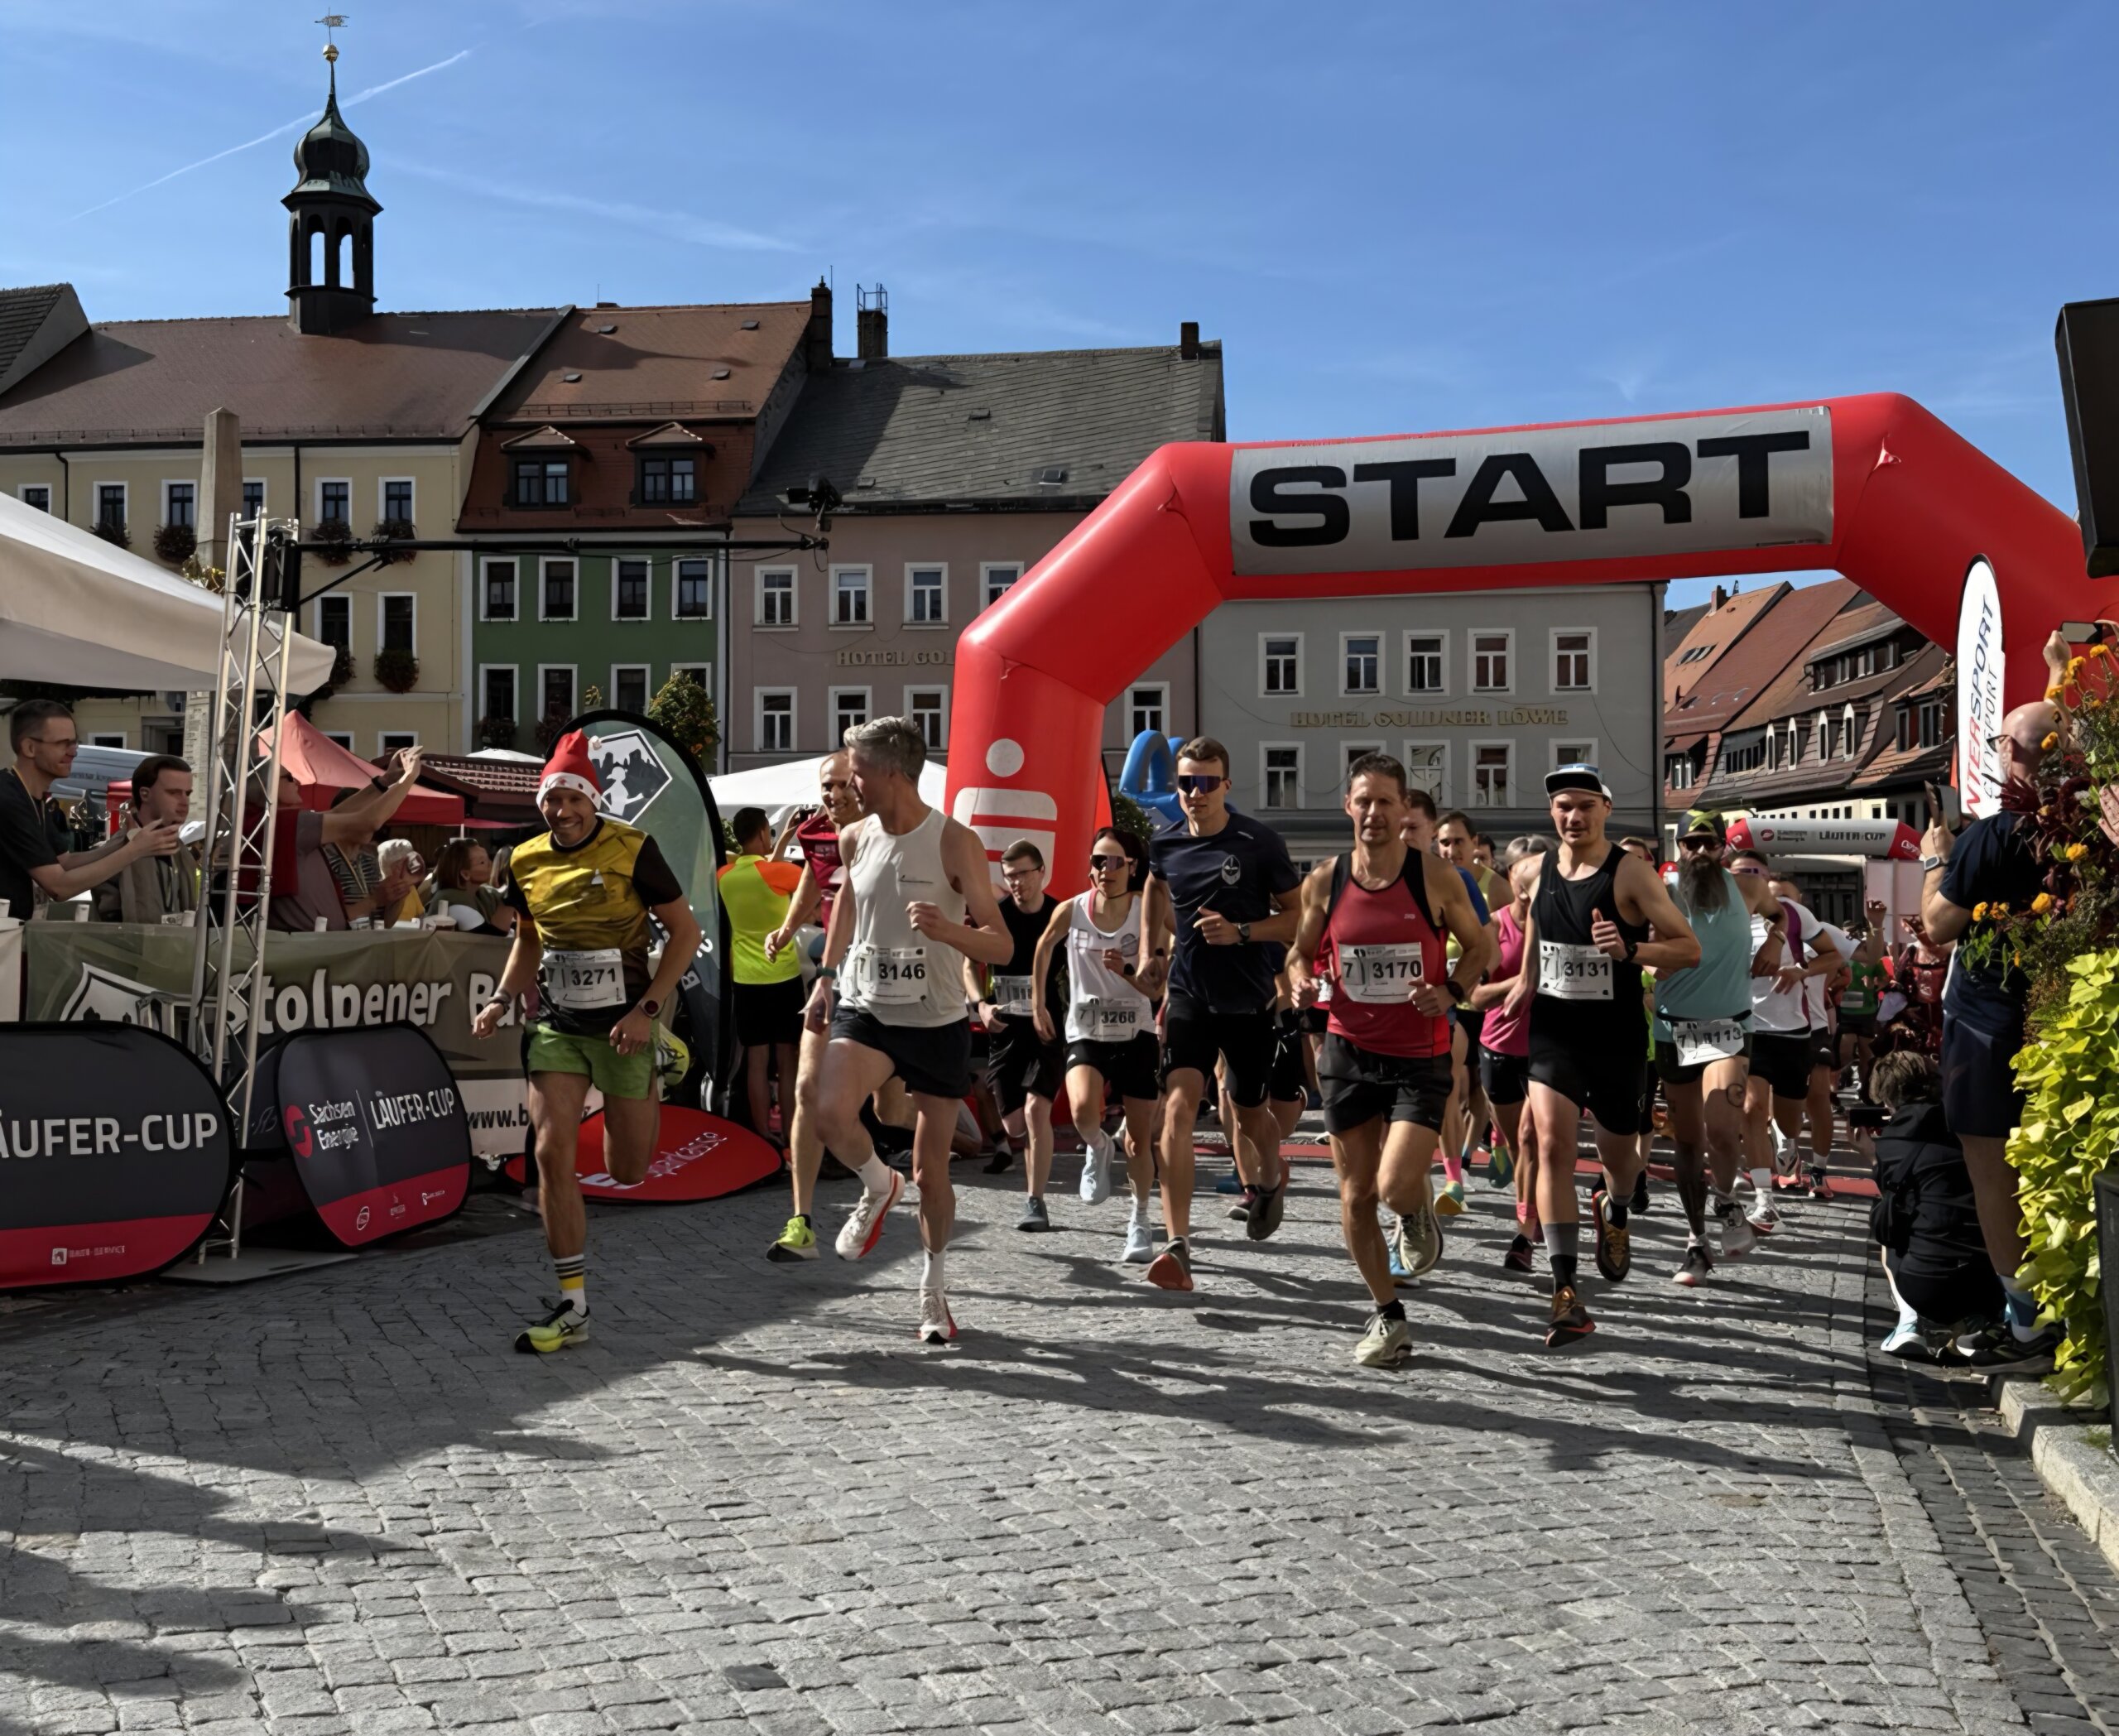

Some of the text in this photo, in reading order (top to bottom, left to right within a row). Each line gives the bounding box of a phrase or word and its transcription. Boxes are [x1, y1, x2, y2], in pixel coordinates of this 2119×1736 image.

[1249, 430, 1809, 547] START
[1966, 594, 1993, 820] NTERSPORT
[1982, 663, 1997, 799] CTYSPORT
[571, 967, 616, 985] 3271
[878, 963, 925, 980] 3146
[1343, 960, 1421, 979] 7 3170
[1564, 961, 1609, 978] 3131
[226, 969, 452, 1036] Stolpener
